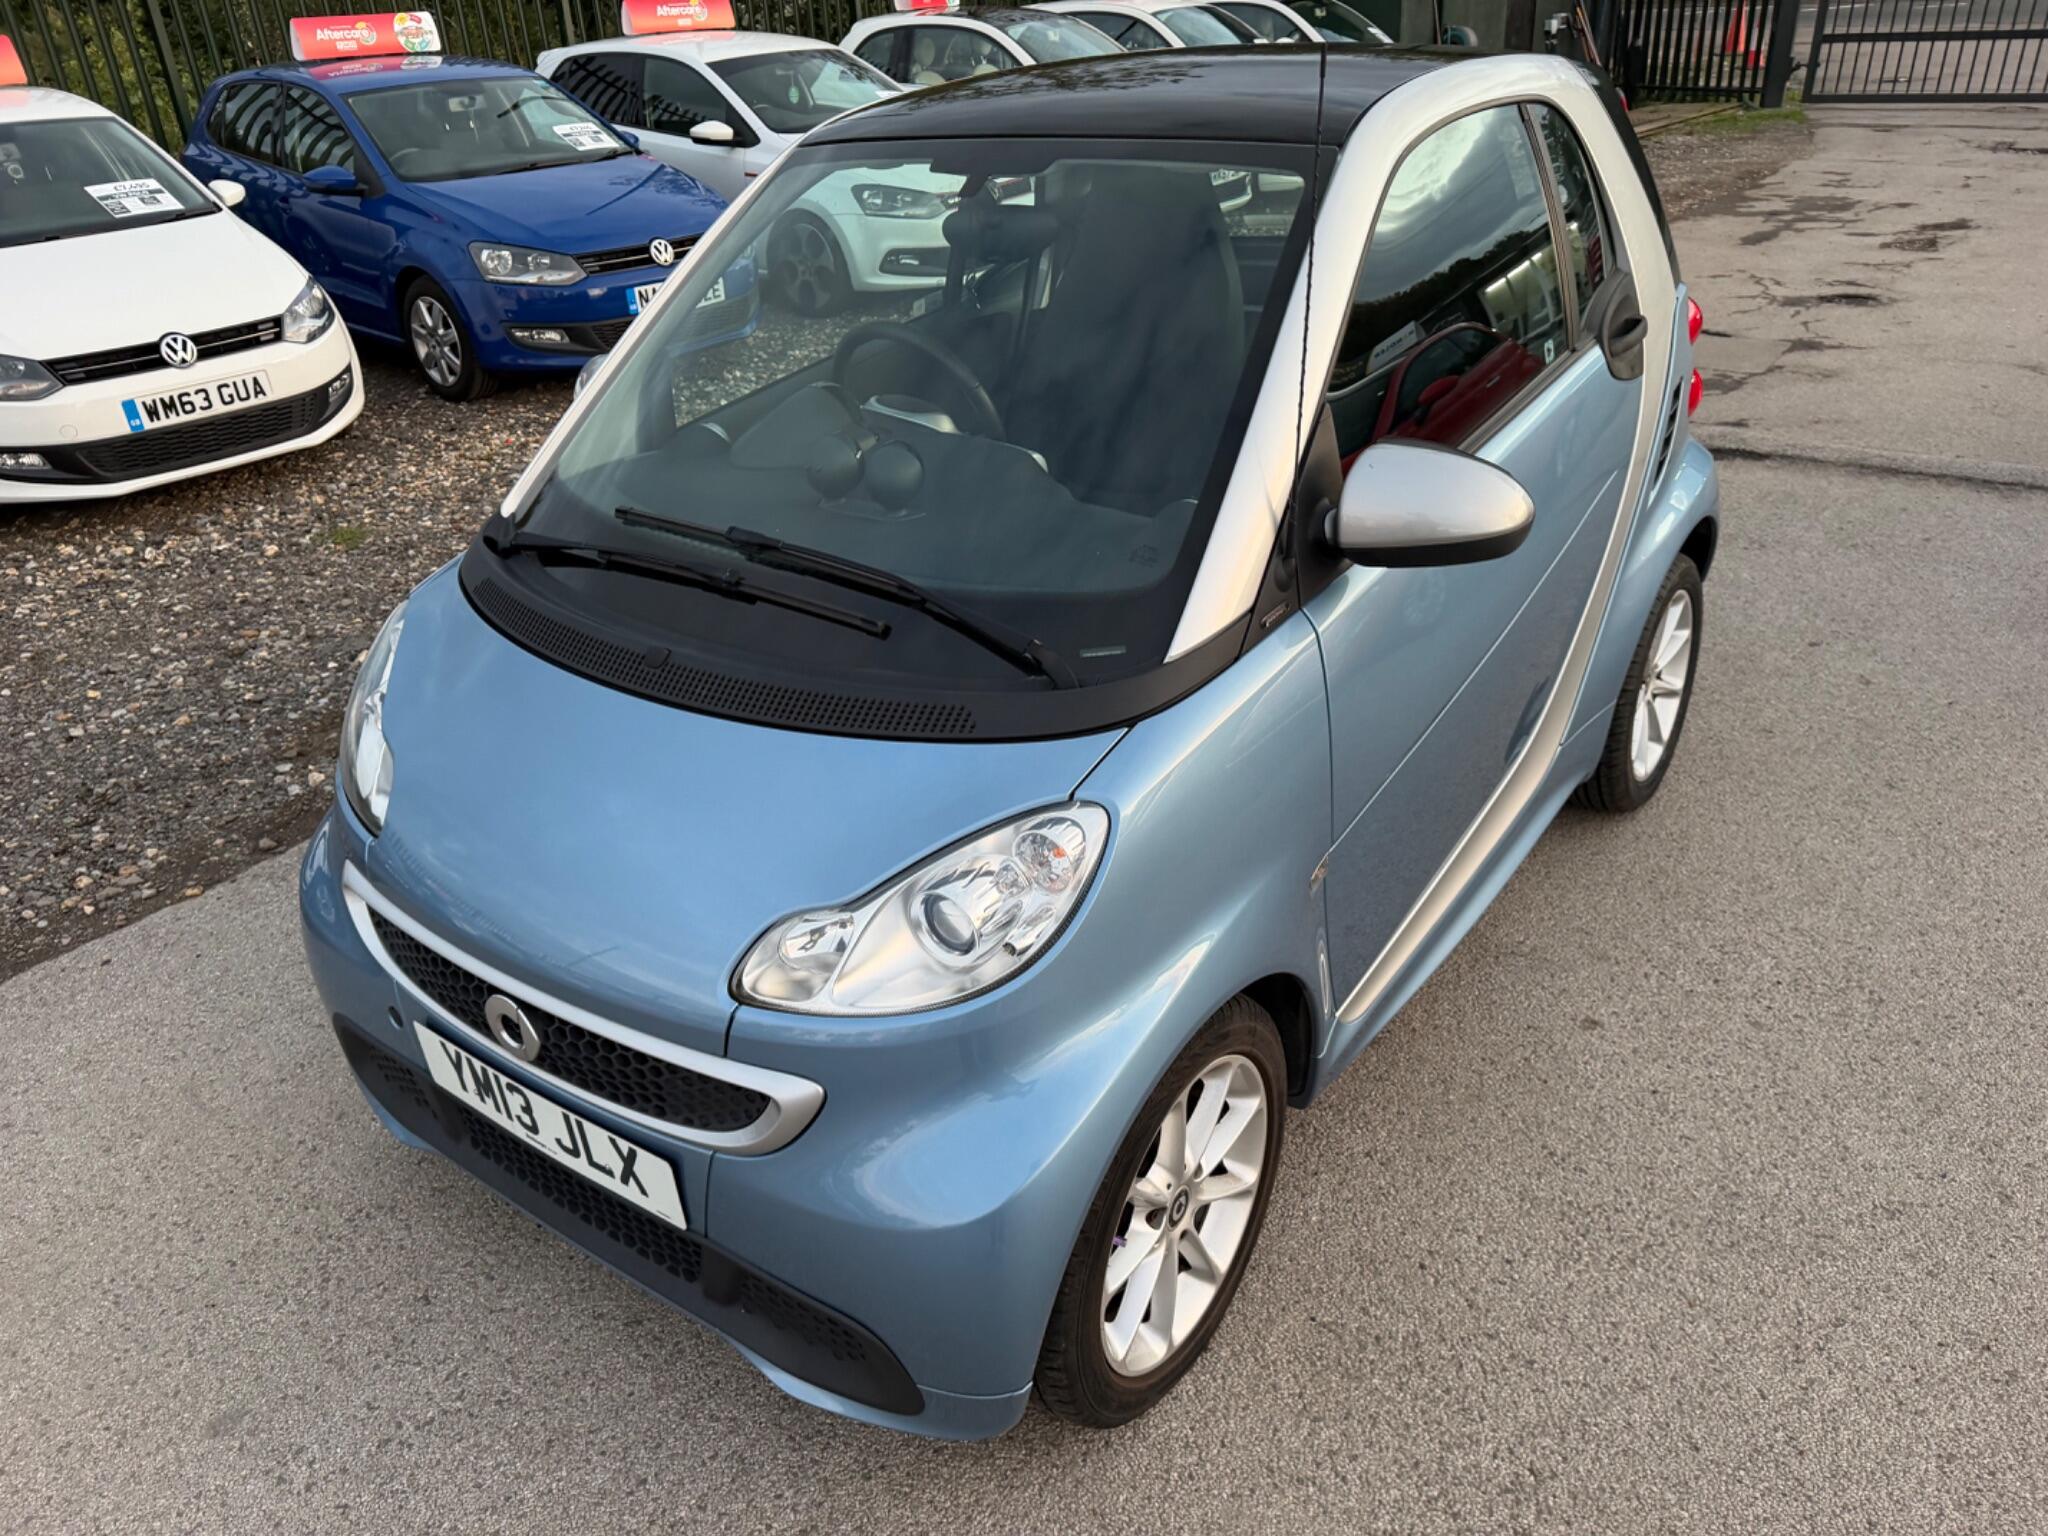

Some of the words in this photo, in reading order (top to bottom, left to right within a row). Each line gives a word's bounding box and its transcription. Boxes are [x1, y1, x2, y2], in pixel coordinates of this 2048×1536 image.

[315, 28, 370, 41] Aftercare
[142, 387, 213, 423] WM63
[216, 376, 267, 406] GUA
[439, 1040, 540, 1135] YM13
[554, 1110, 649, 1198] JLX
